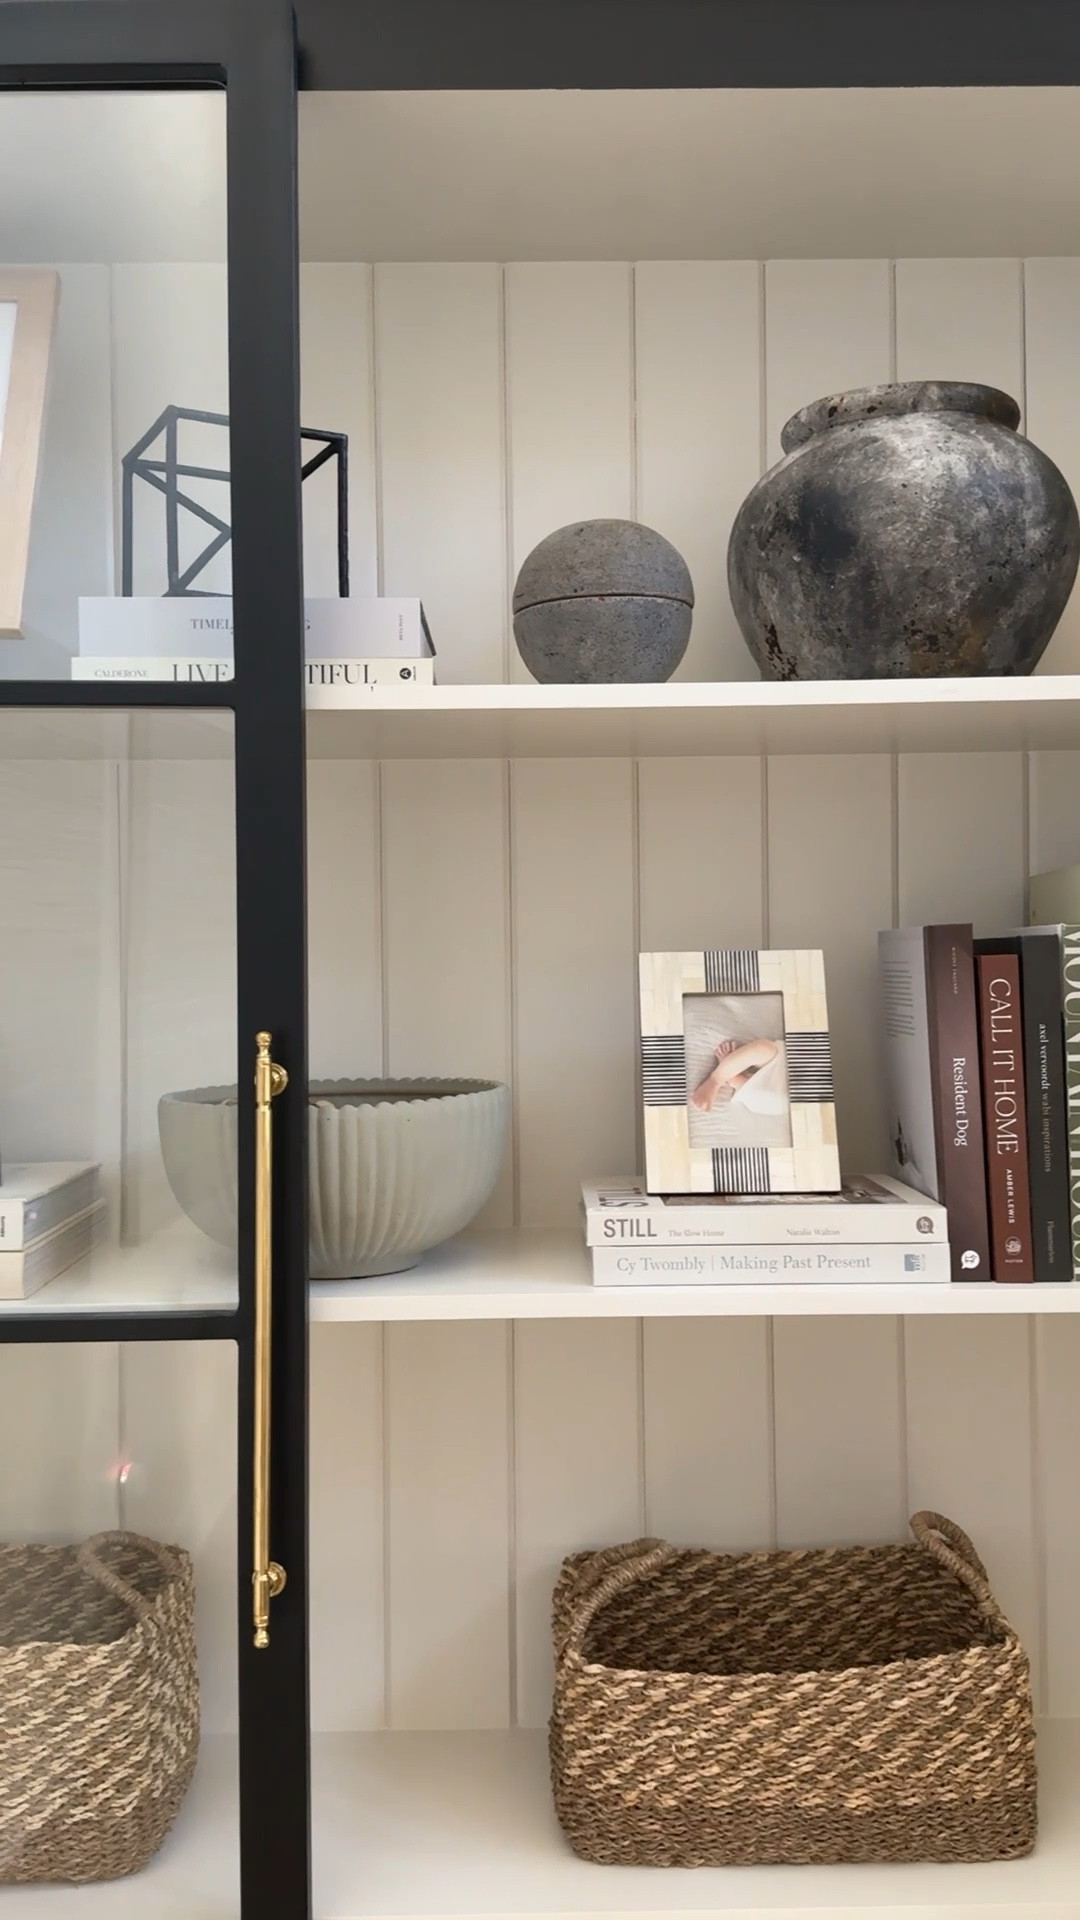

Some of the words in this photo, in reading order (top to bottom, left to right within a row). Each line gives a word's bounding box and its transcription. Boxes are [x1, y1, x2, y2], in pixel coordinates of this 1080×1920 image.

[190, 618, 234, 630] TIMEL
[94, 669, 149, 679] CALDERONE
[173, 664, 229, 682] LIVE
[304, 664, 377, 684] TIFUL
[988, 978, 1013, 1042] CALL
[1039, 1024, 1049, 1043] axel
[992, 1049, 1015, 1071] IT
[1040, 1045, 1052, 1090] vervoordt
[952, 1057, 968, 1115] Resident
[1042, 1092, 1052, 1116] wabi
[994, 1079, 1019, 1155] HOME
[954, 1119, 969, 1146] Dog
[1041, 1118, 1053, 1173] inspirations
[1006, 1168, 1015, 1197] AMBER
[1007, 1198, 1016, 1224] LEWIS
[603, 1218, 658, 1238] STILL
[668, 1229, 682, 1237] The
[616, 1257, 636, 1275] Cy
[640, 1256, 706, 1274] Twombly
[720, 1255, 778, 1273] Making
[783, 1254, 812, 1269] Past
[816, 1254, 872, 1269] Present
